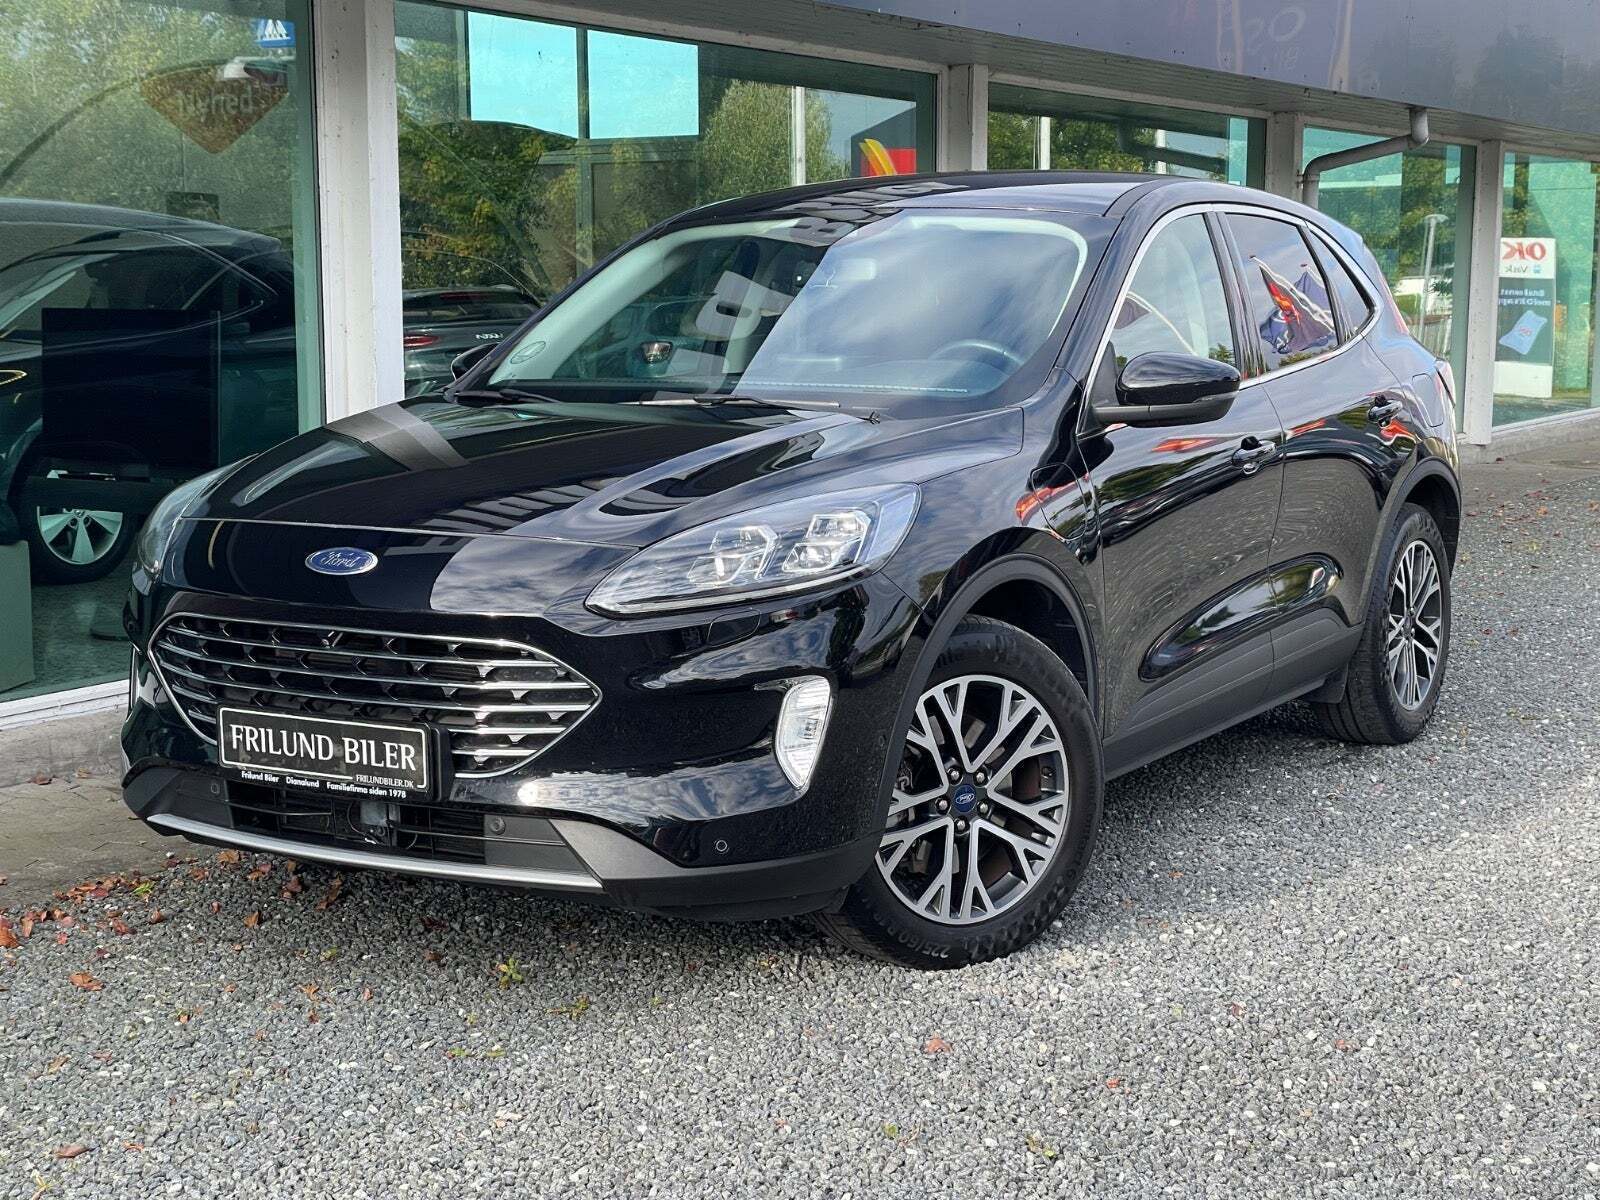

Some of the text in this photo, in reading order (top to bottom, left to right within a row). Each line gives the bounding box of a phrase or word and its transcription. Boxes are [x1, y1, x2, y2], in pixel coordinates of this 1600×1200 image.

[320, 551, 361, 568] Ford
[230, 724, 417, 771] FRILUND BILER
[241, 770, 406, 799] Frilund Biler Dianalund Familiefirma siden 1978
[355, 774, 414, 788] FRILUNDBILER.DK
